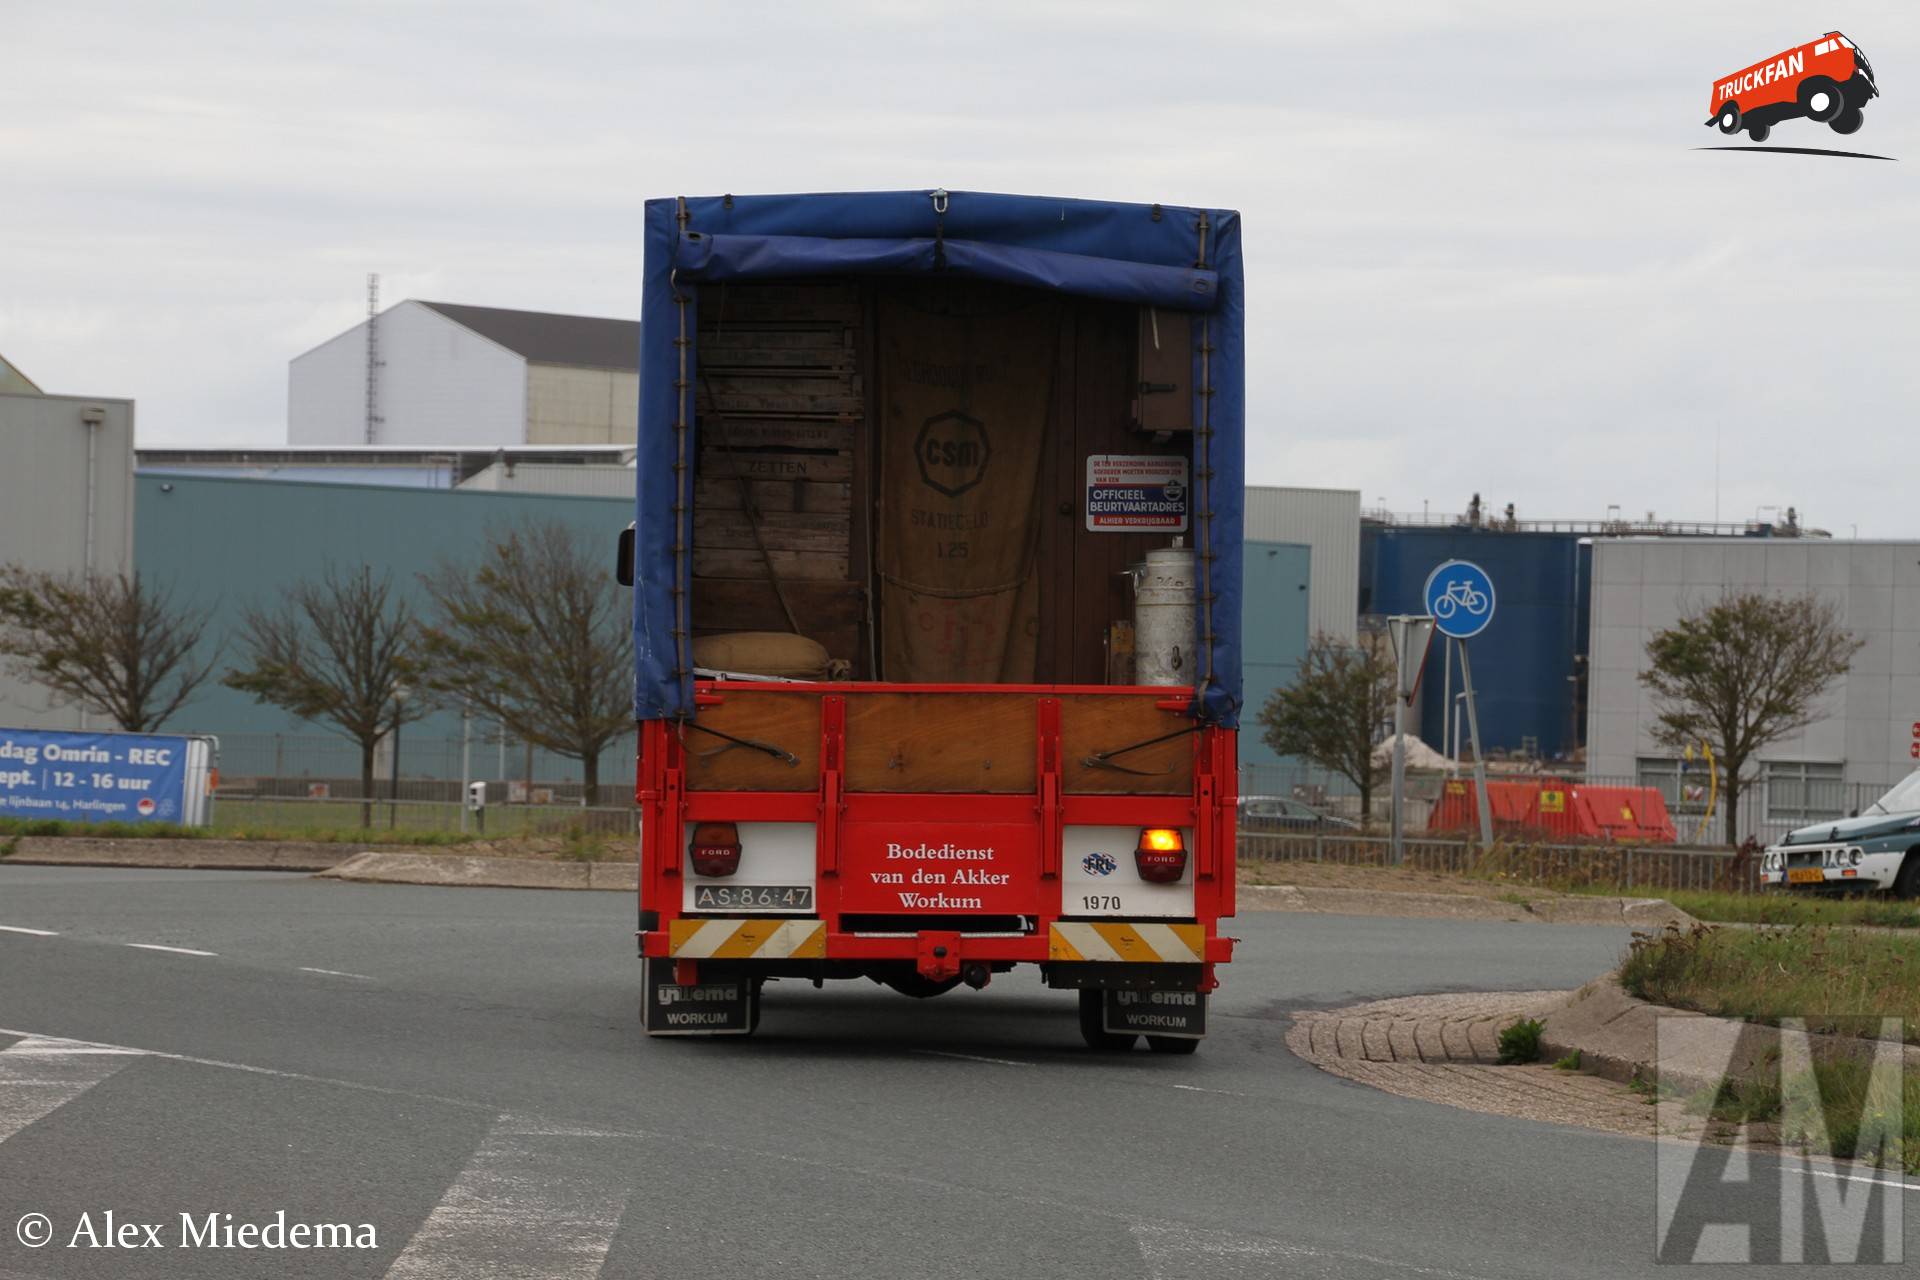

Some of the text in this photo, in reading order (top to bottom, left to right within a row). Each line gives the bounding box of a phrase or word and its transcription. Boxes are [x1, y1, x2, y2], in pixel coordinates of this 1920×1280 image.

[1093, 489, 1146, 500] OFFICIEEL
[1090, 501, 1185, 512] BEURTVAARTADRES
[1098, 517, 1176, 526] ALHIER VERKRIJGBAAR
[43, 744, 110, 763] Omrin
[128, 749, 171, 766] REC
[53, 771, 75, 788] 12
[91, 773, 114, 789] 16
[117, 778, 152, 790] uur
[73, 799, 127, 813] Harlingen
[886, 843, 994, 860] Bodedienst
[870, 868, 1010, 885] van den Akker
[897, 892, 982, 909] Workum
[1082, 895, 1121, 910] 1970
[666, 1013, 729, 1024] WORKUM
[1126, 1014, 1187, 1027] WORKUM
